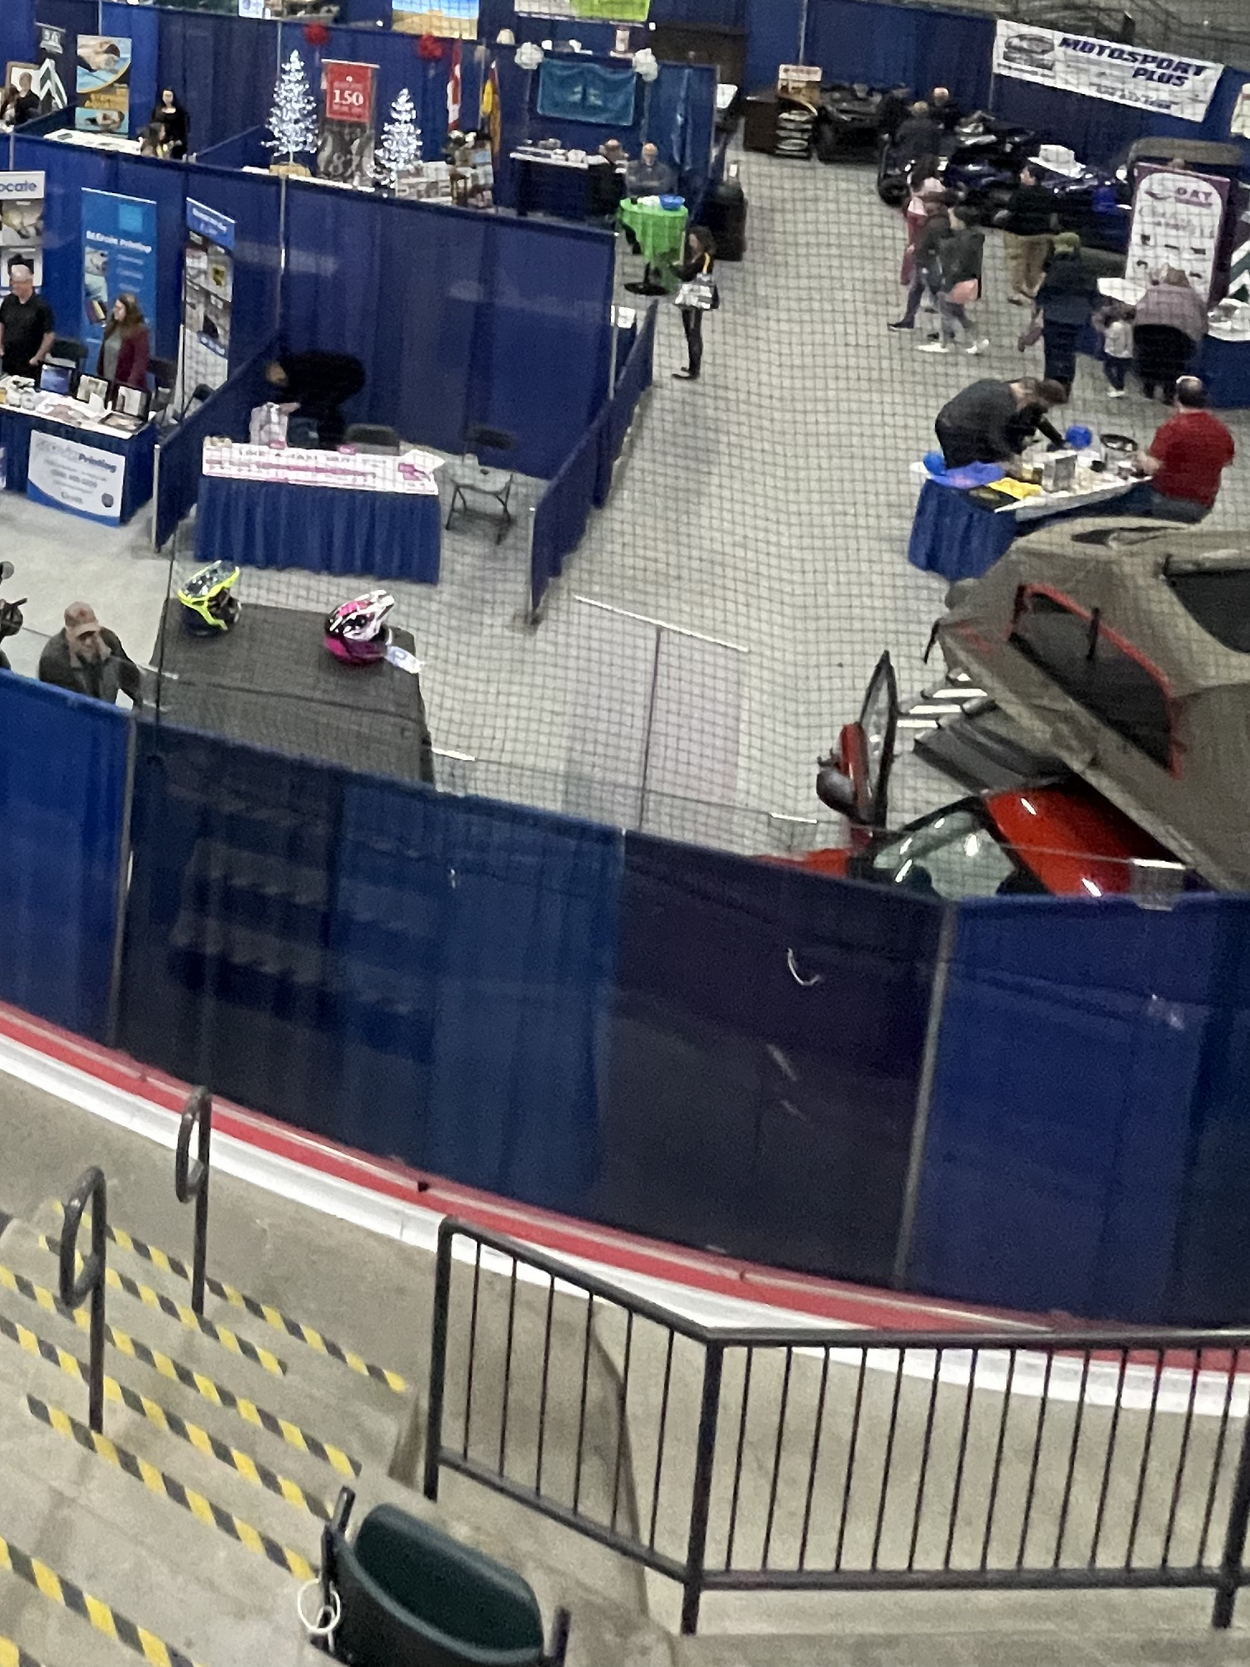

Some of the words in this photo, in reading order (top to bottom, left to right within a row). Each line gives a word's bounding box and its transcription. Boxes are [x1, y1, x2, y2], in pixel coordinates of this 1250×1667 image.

[1058, 36, 1209, 76] MOTOSPORT
[1132, 66, 1189, 87] PLUS
[333, 89, 364, 106] 150
